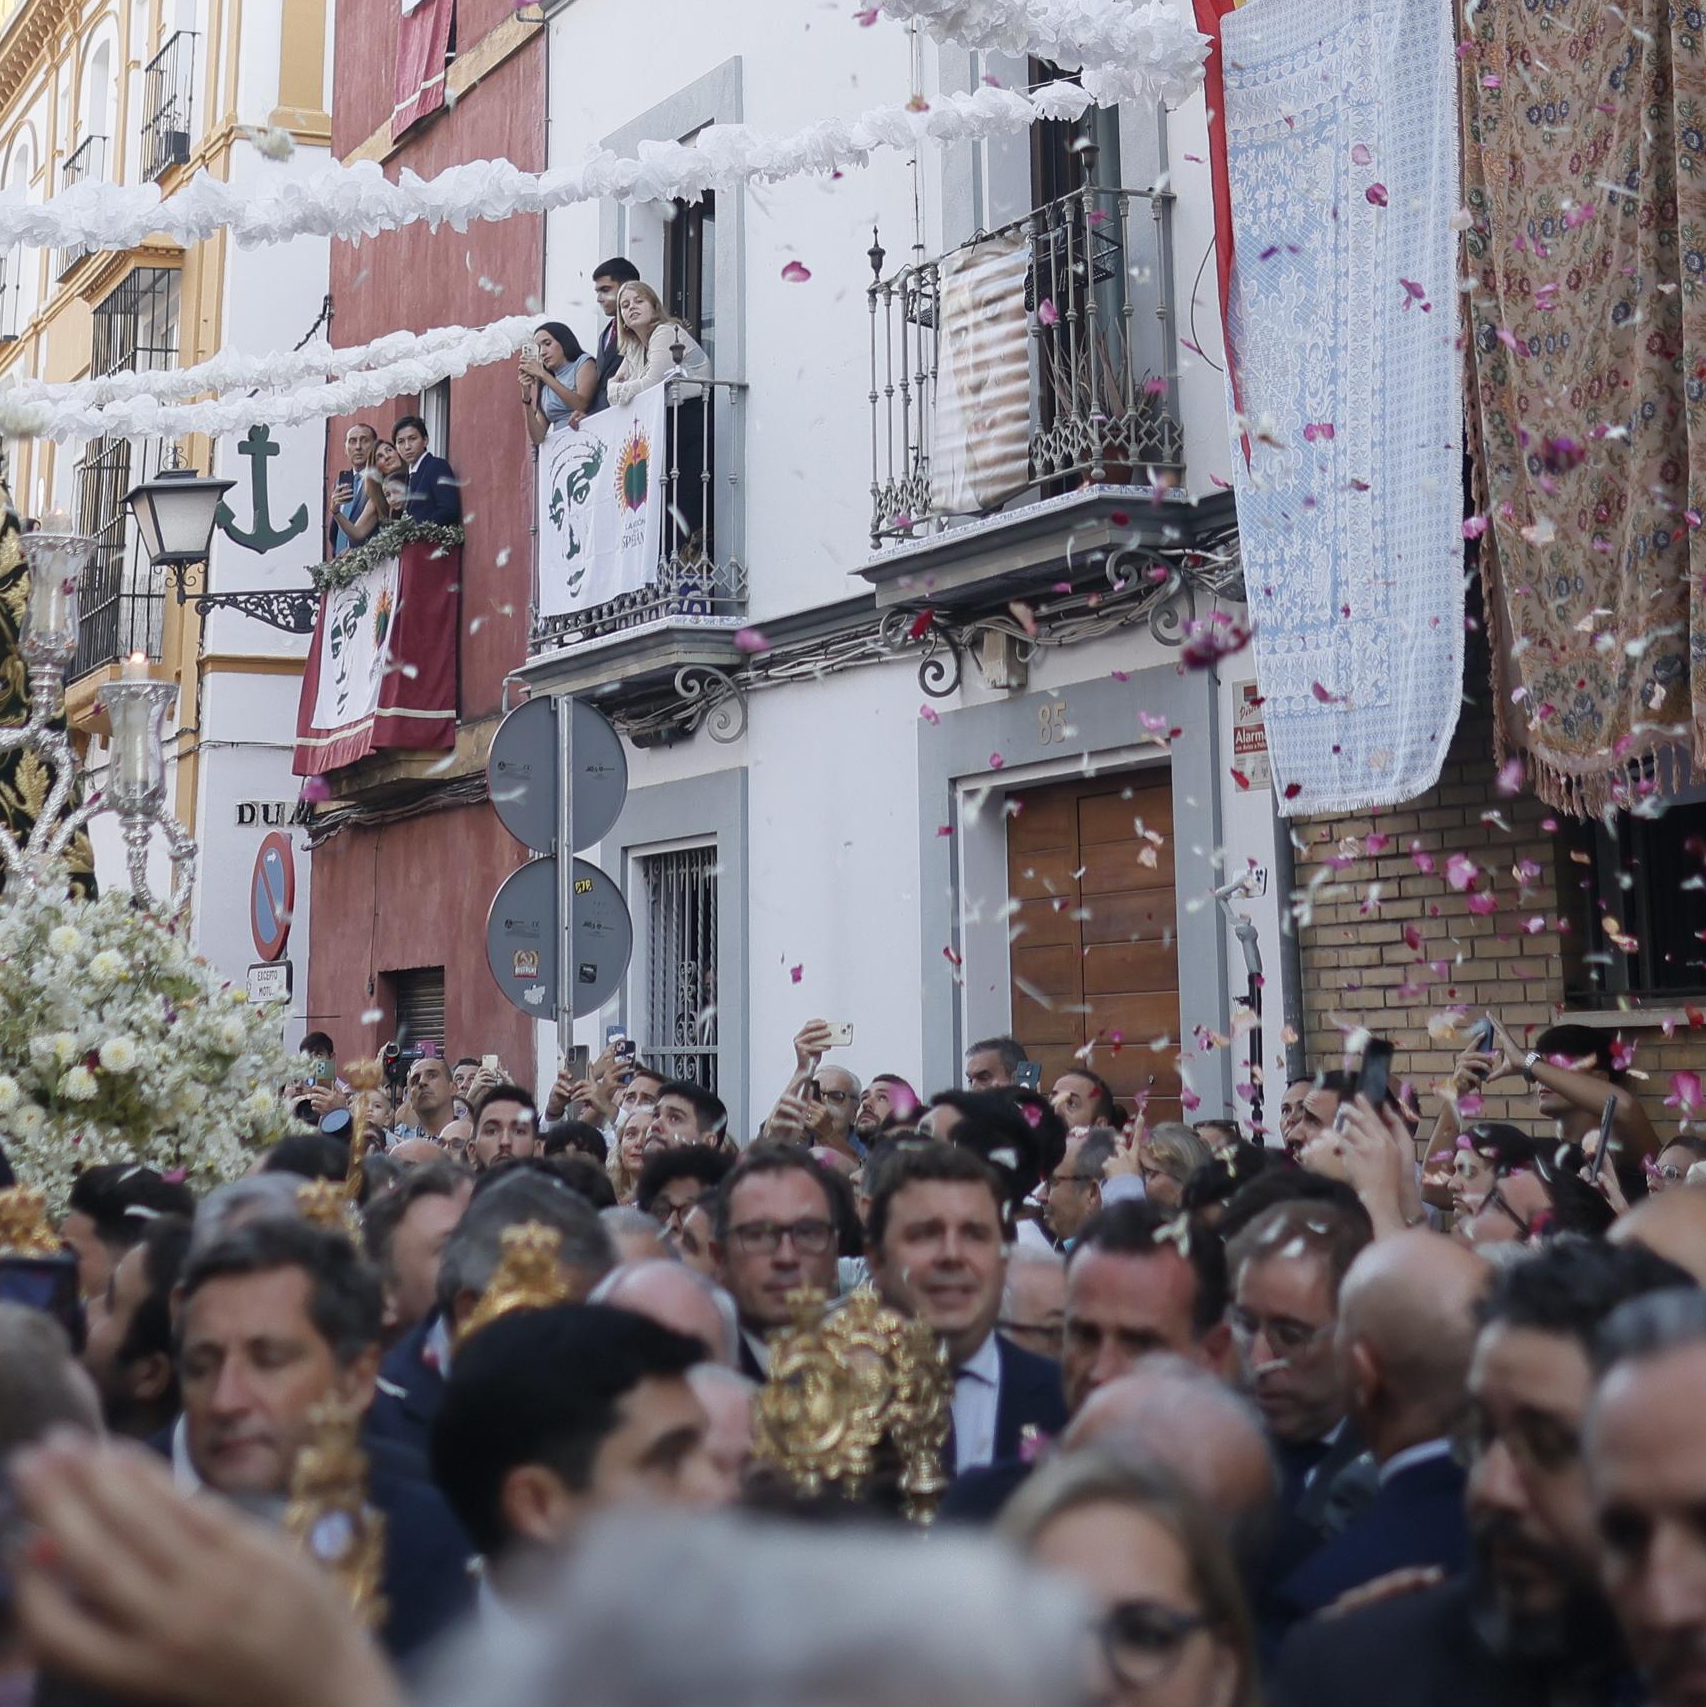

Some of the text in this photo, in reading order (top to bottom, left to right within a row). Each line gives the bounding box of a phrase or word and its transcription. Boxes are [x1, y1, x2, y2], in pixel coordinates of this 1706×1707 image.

[1037, 700, 1068, 746] 85
[1235, 728, 1267, 744] Alarm
[257, 970, 278, 982] EXCEPTO
